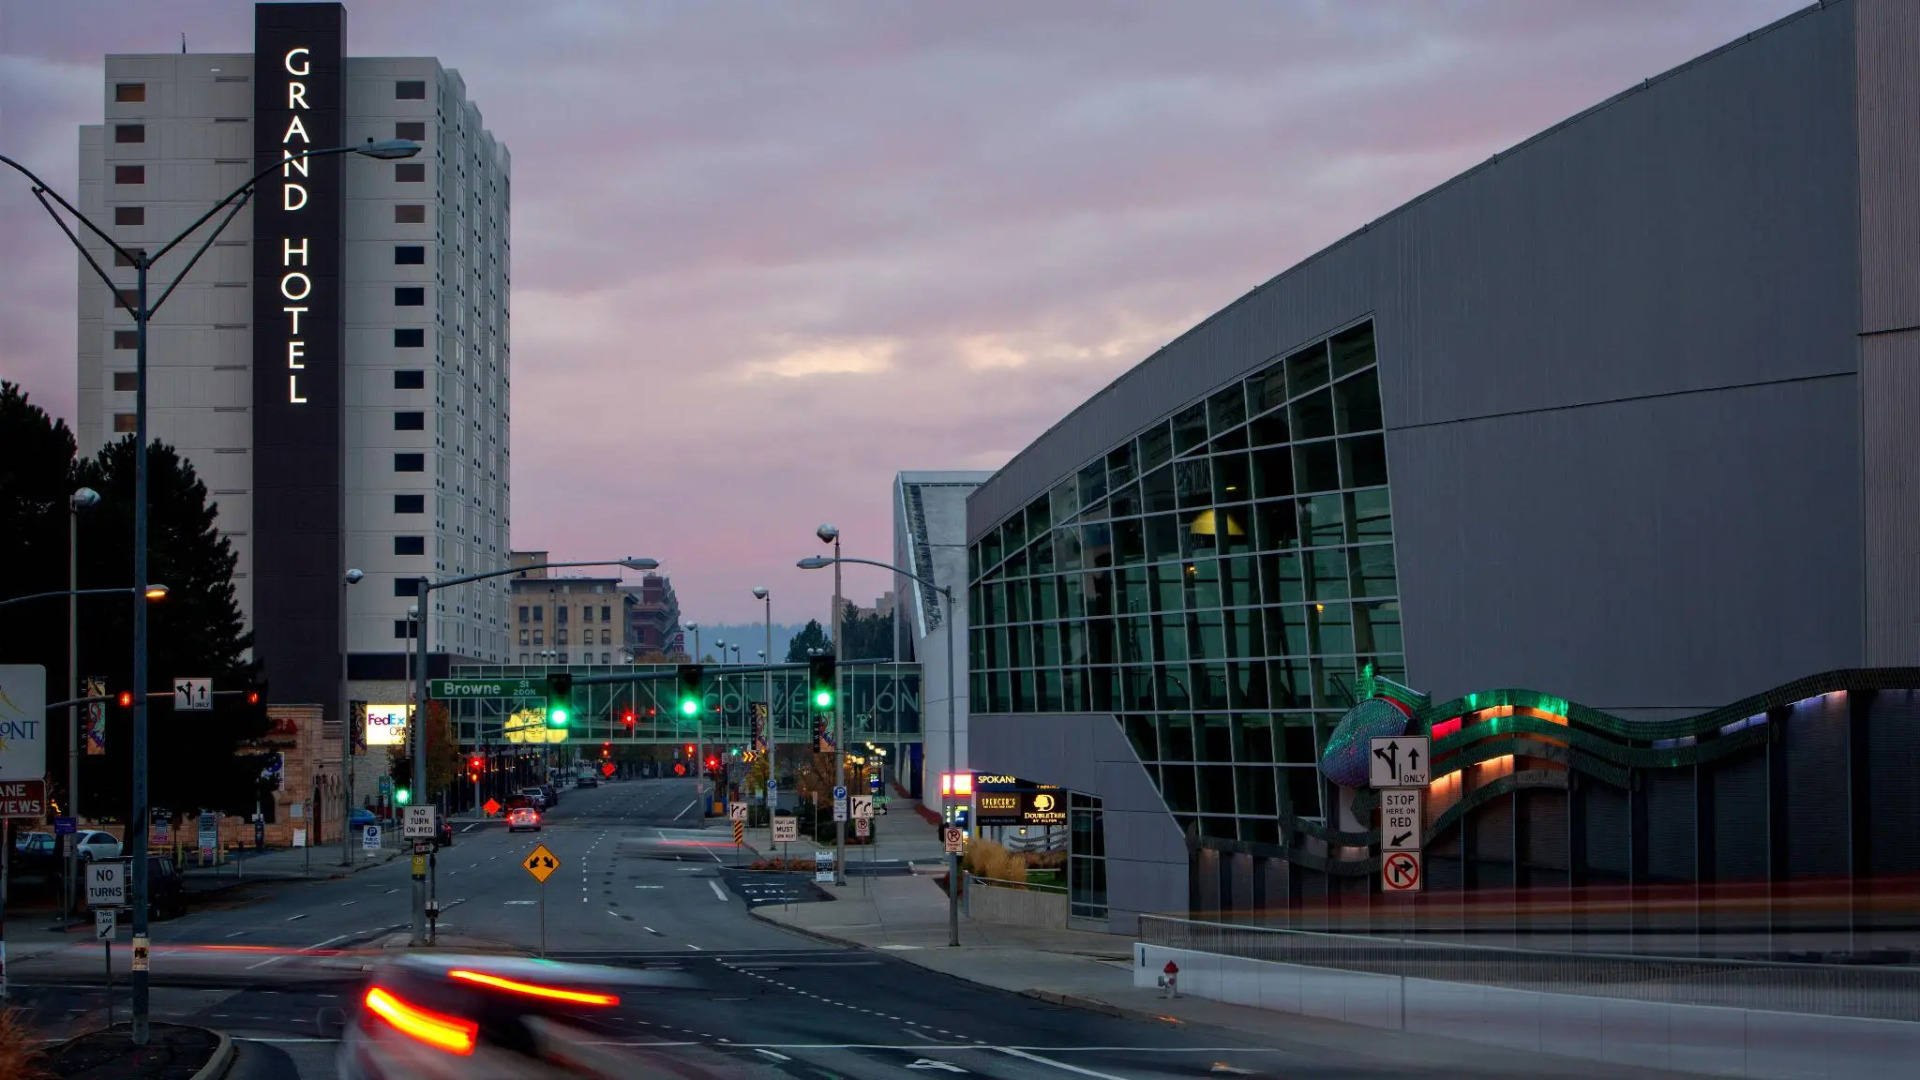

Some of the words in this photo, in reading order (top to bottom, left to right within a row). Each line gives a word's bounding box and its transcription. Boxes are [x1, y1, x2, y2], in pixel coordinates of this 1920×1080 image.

[283, 47, 311, 212] GRAND
[280, 237, 312, 404] HOTEL
[443, 681, 502, 695] Browne
[519, 680, 530, 688] St
[702, 692, 919, 714] COVEION
[368, 713, 406, 726] FedEx
[1403, 774, 1426, 784] ONLY
[981, 797, 1016, 806] SPENCER'S
[1386, 795, 1415, 805] STOP
[410, 817, 430, 825] TURN
[1390, 817, 1412, 828] RED
[96, 869, 114, 882] NO
[89, 887, 122, 897] TURNS
